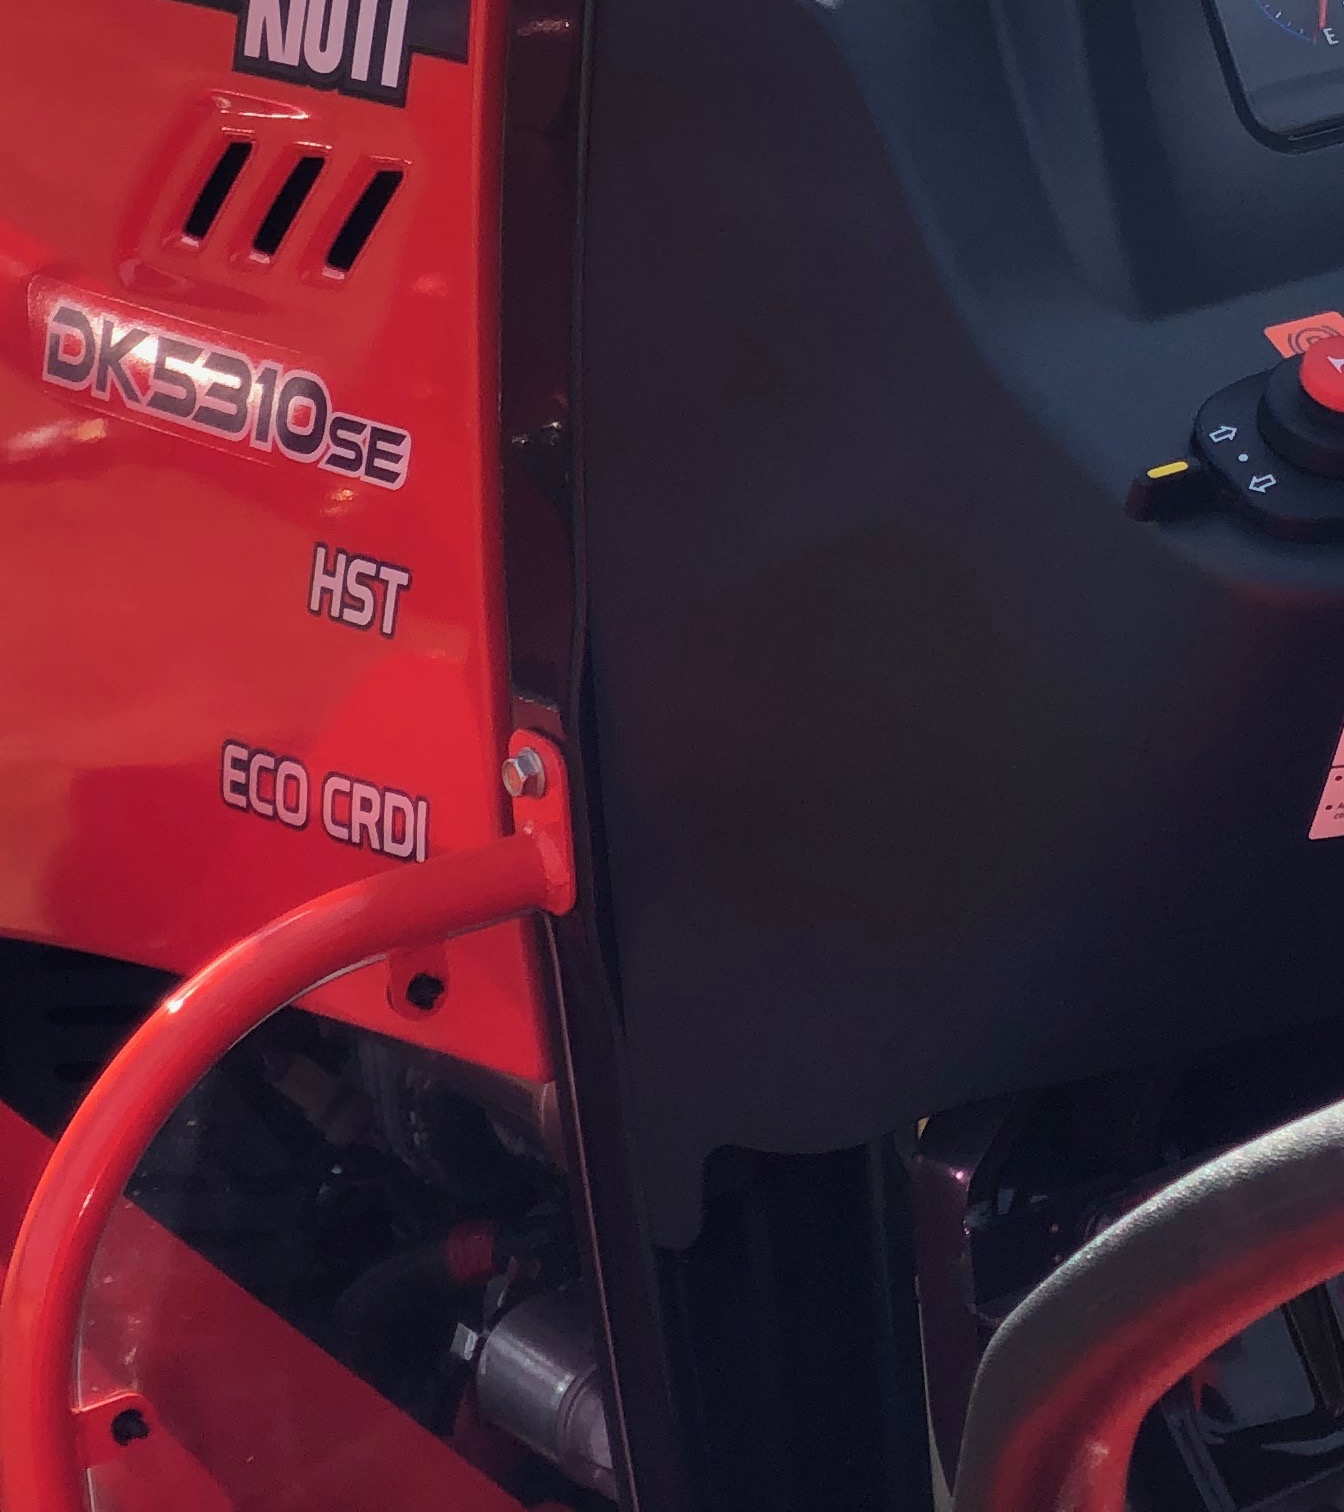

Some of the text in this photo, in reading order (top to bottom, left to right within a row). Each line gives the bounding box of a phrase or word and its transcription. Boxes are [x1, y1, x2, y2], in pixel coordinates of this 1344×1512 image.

[1323, 27, 1339, 45] E
[45, 303, 409, 486] DK5310SE
[308, 544, 410, 635] HST
[222, 743, 427, 863] ECO CRDI
